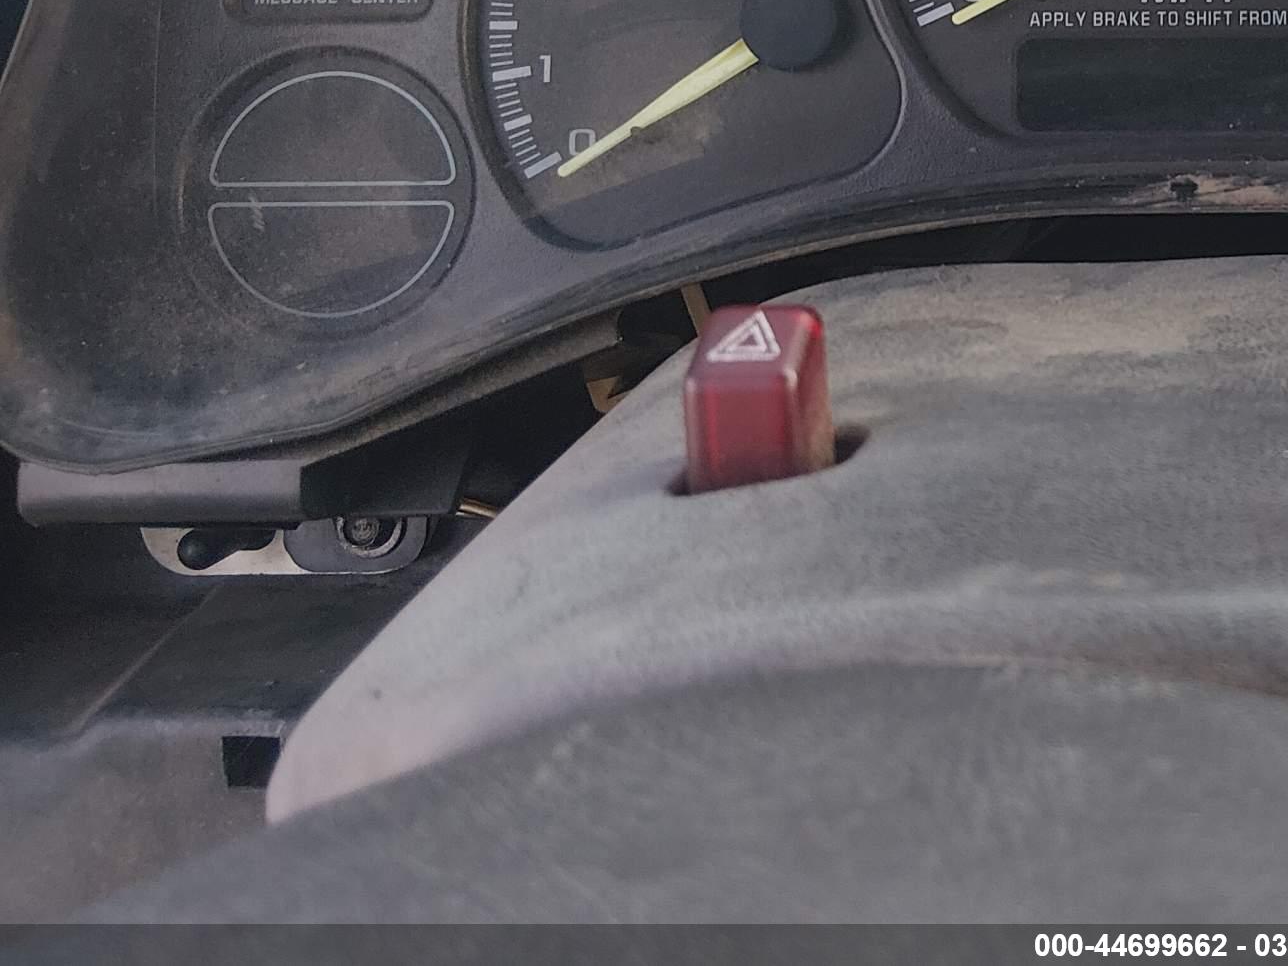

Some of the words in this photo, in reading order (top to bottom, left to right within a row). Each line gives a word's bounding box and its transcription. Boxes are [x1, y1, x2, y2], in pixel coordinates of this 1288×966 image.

[1029, 11, 1087, 27] APPLY
[1093, 11, 1151, 27] BRAKE
[1156, 10, 1180, 26] TO
[1184, 10, 1235, 26] SHIFT
[1239, 10, 1288, 26] FROM
[539, 55, 552, 83] 1
[567, 129, 596, 156] 0
